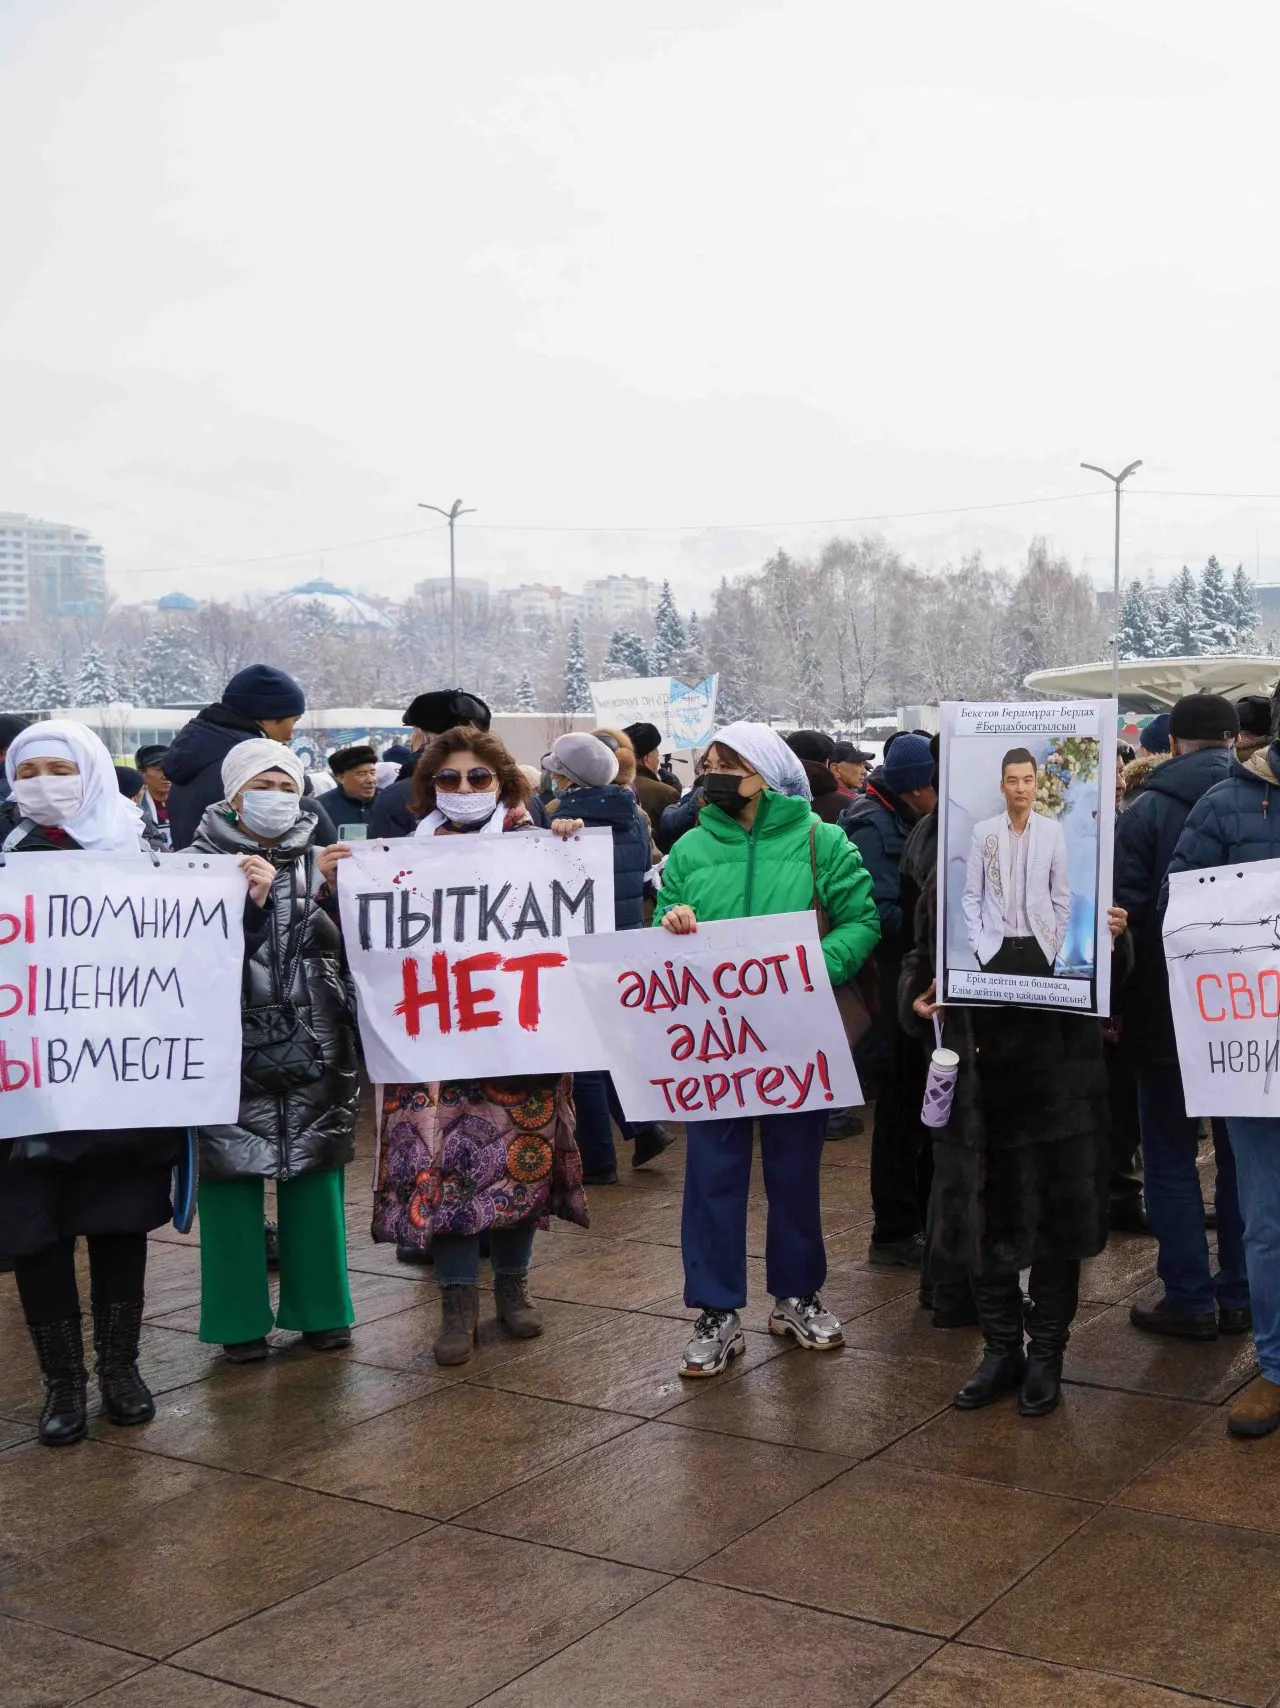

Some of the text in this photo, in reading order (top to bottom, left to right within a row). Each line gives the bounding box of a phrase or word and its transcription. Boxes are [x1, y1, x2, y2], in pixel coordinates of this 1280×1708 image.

[961, 707, 999, 718] Бекетов
[975, 720, 1077, 733] #Бердахбосатылсын
[0, 894, 229, 945] Ы ПОМНИМ
[355, 877, 596, 951] ПЫТКАМ
[0, 964, 185, 1018] Ы ЦЕНИМ
[392, 950, 569, 1042] НЕТ
[951, 985, 972, 995] Елім
[973, 987, 1002, 998] дейтін
[1003, 991, 1013, 1001] ер
[1048, 992, 1087, 1004] болсын?
[966, 973, 1070, 991] Ерім дейтін ел болмаса,
[0, 1037, 205, 1092] Ы ВМЕСТЕ
